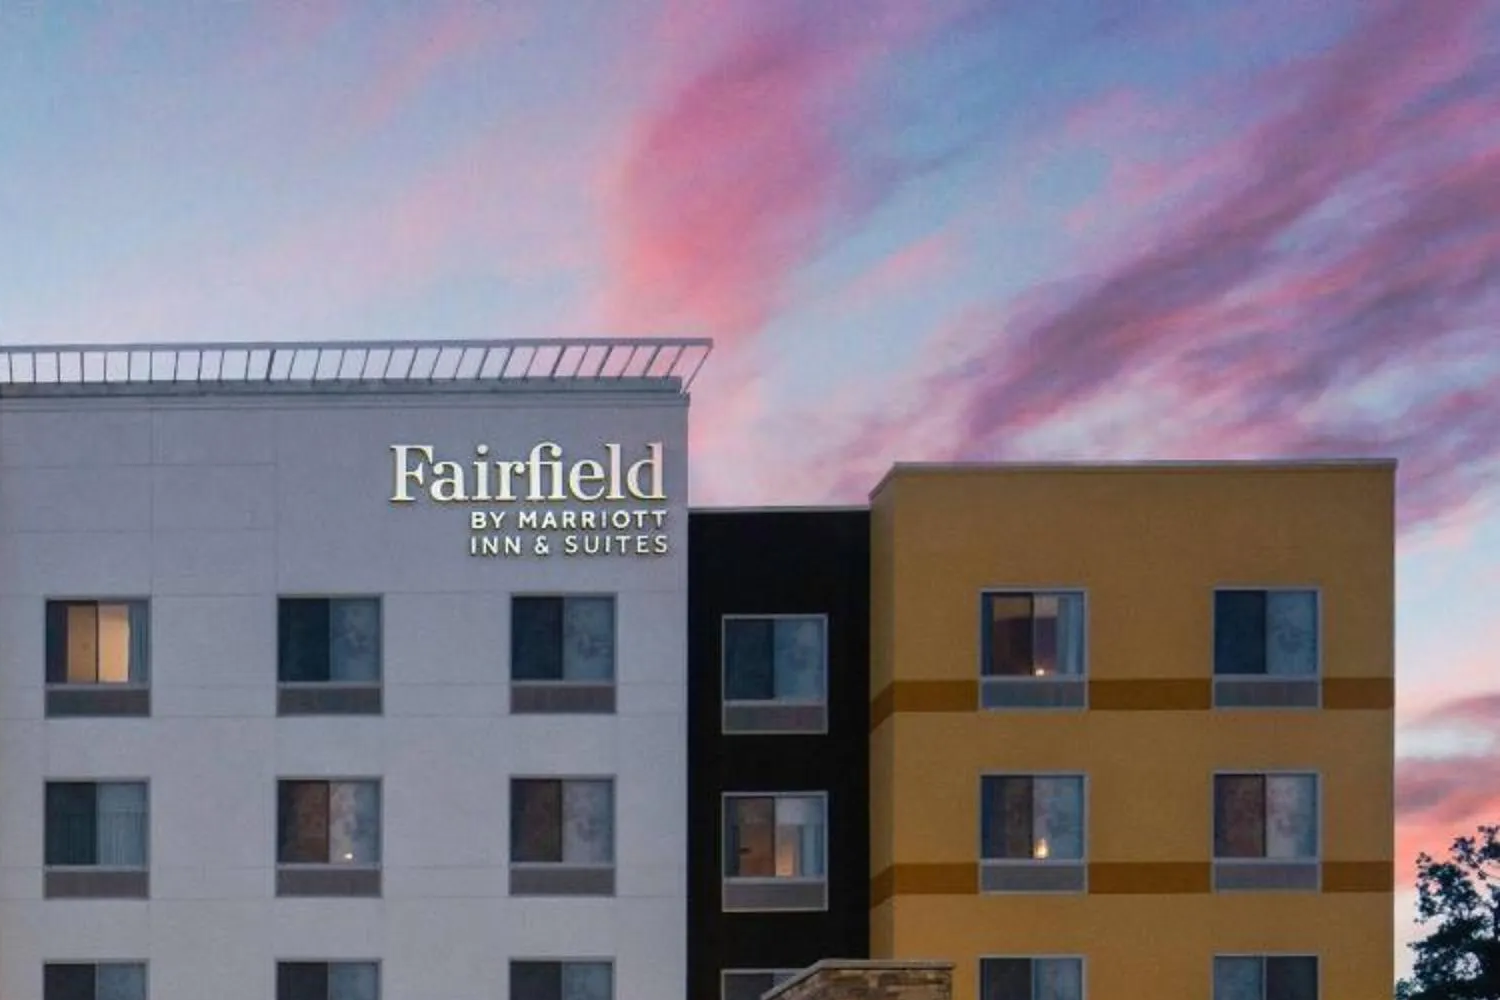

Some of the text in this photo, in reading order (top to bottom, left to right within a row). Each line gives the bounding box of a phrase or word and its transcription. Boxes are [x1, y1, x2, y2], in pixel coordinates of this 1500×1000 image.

[389, 441, 667, 501] Fairfield
[471, 511, 668, 529] BY MARRIOTT
[470, 535, 668, 554] INN & SUITES
